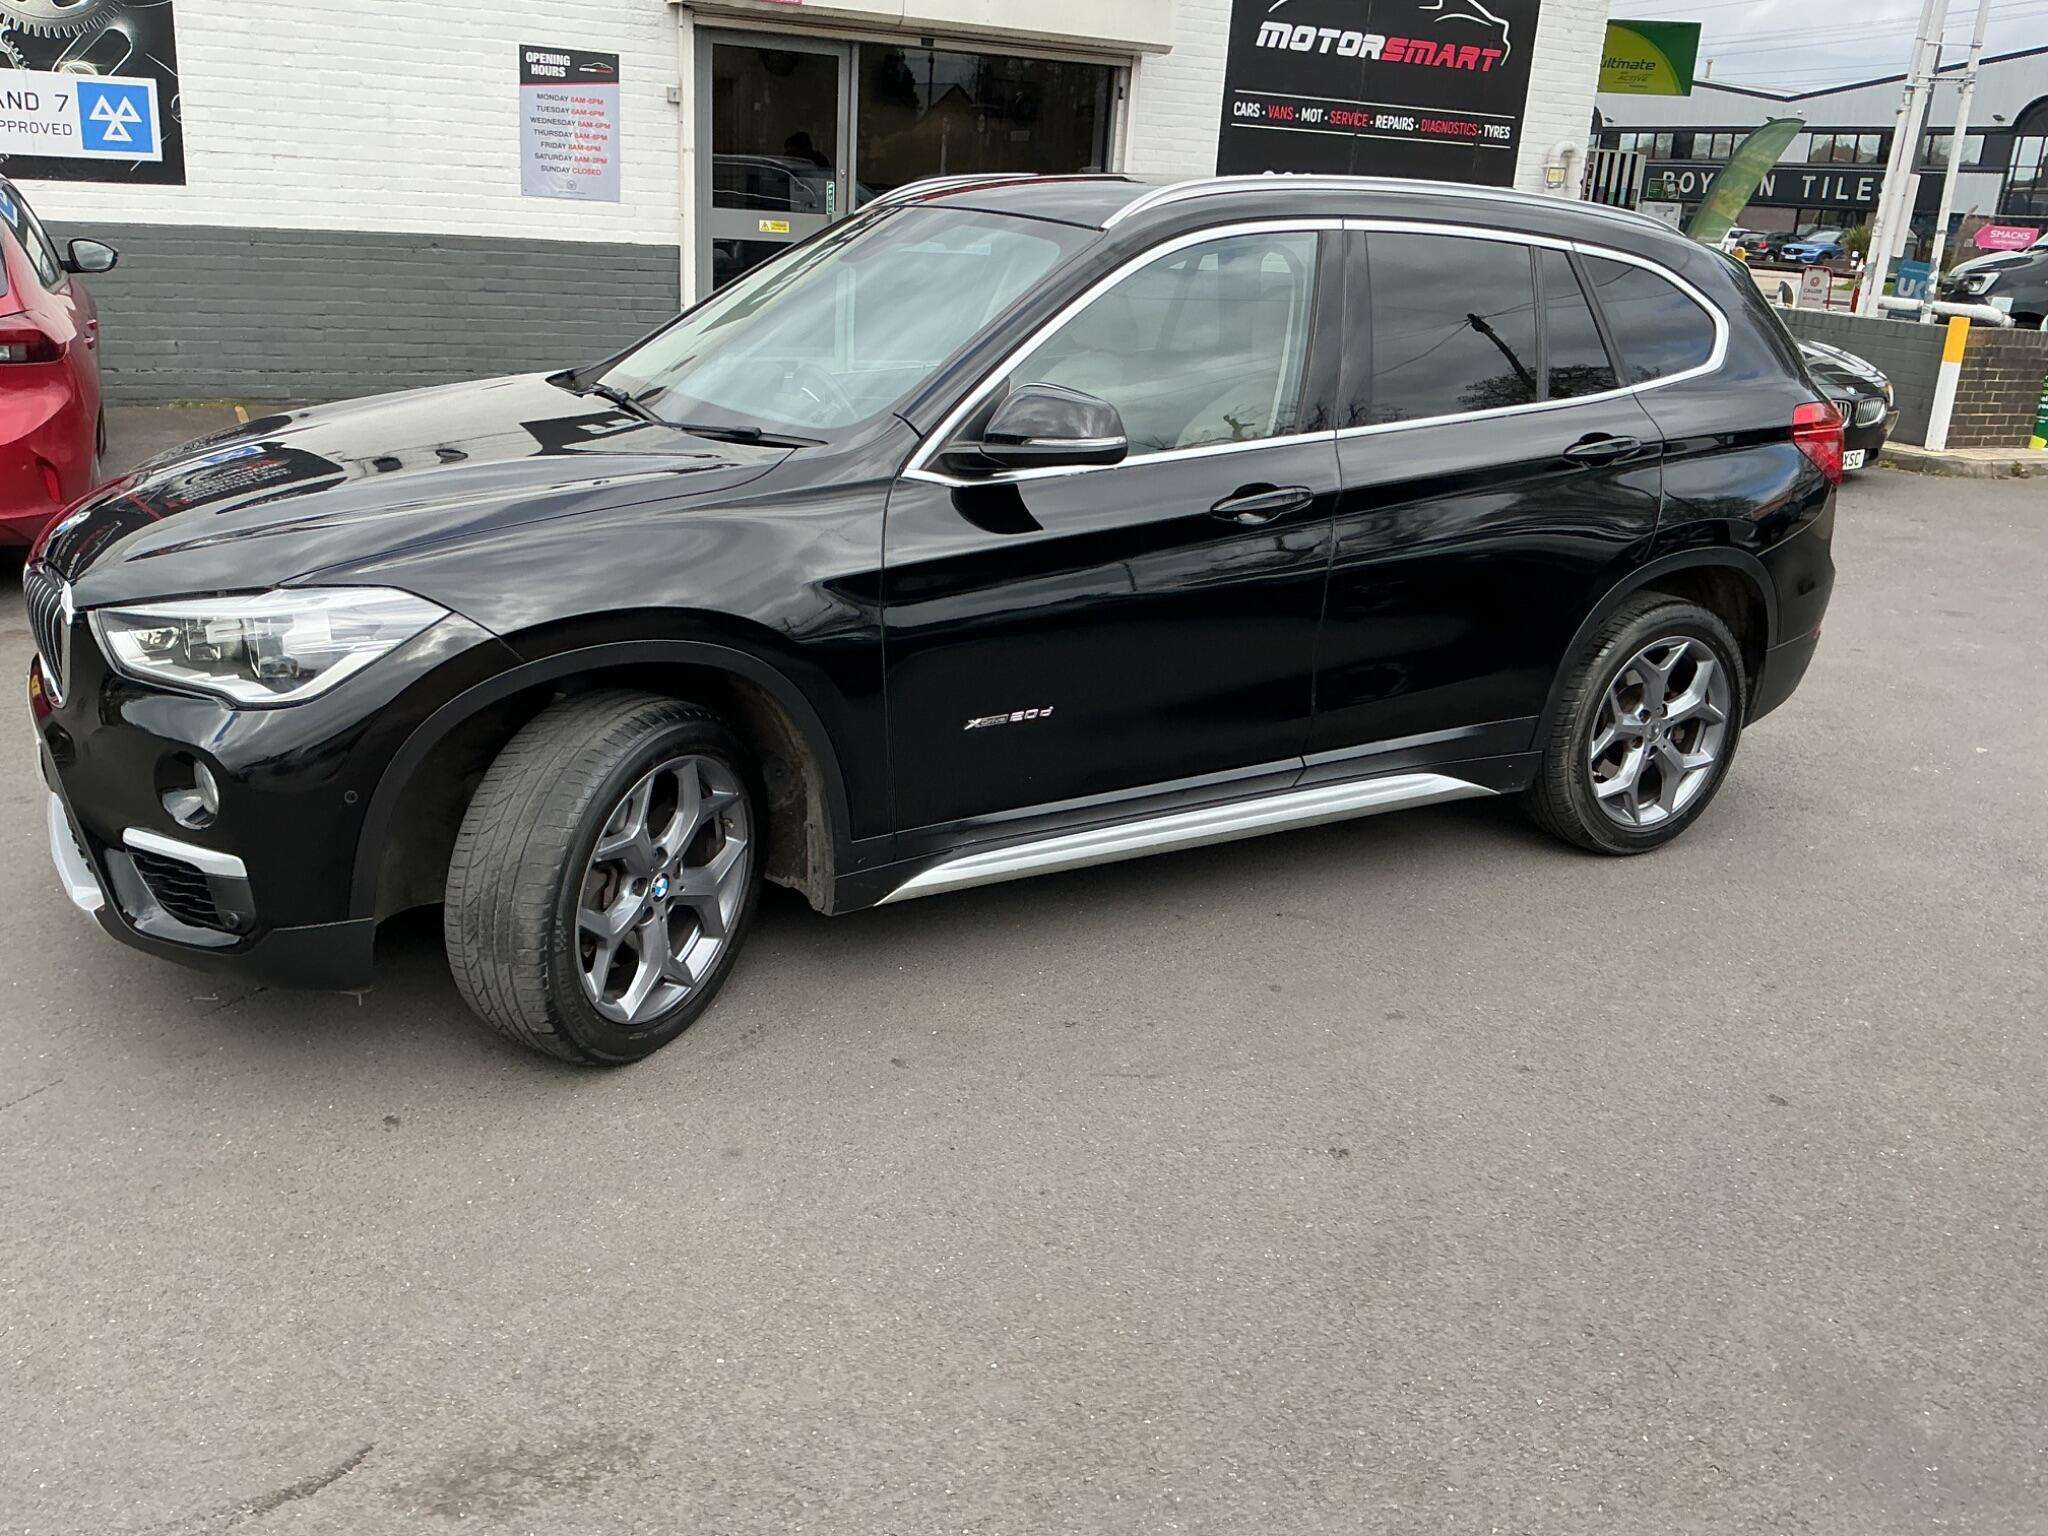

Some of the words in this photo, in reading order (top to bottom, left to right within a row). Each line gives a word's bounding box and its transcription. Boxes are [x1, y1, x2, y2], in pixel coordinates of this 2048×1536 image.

[1256, 20, 1502, 72] MOTORSMART
[525, 51, 570, 66] OPENING
[530, 63, 566, 77] HOURS
[54, 94, 69, 112] 7
[536, 93, 569, 101] MONDAY
[536, 105, 570, 114] TUESDAY
[529, 116, 576, 127] WEDNESDAY
[1233, 101, 1261, 118] CARS
[1268, 104, 1294, 120] VANS
[1301, 107, 1323, 123] MOT
[1329, 110, 1369, 127] SERVICE
[1374, 114, 1415, 132] REPAIRS
[1420, 118, 1478, 137] DIAGNOSTICS
[1483, 124, 1511, 140] TYRES
[533, 128, 573, 138] THURSDAY
[540, 141, 567, 150] FRIDAY
[534, 152, 573, 162] SATURDAY
[540, 164, 571, 174] SUNDAY
[572, 167, 602, 176] CLOSED
[1802, 174, 1884, 202] TILE
